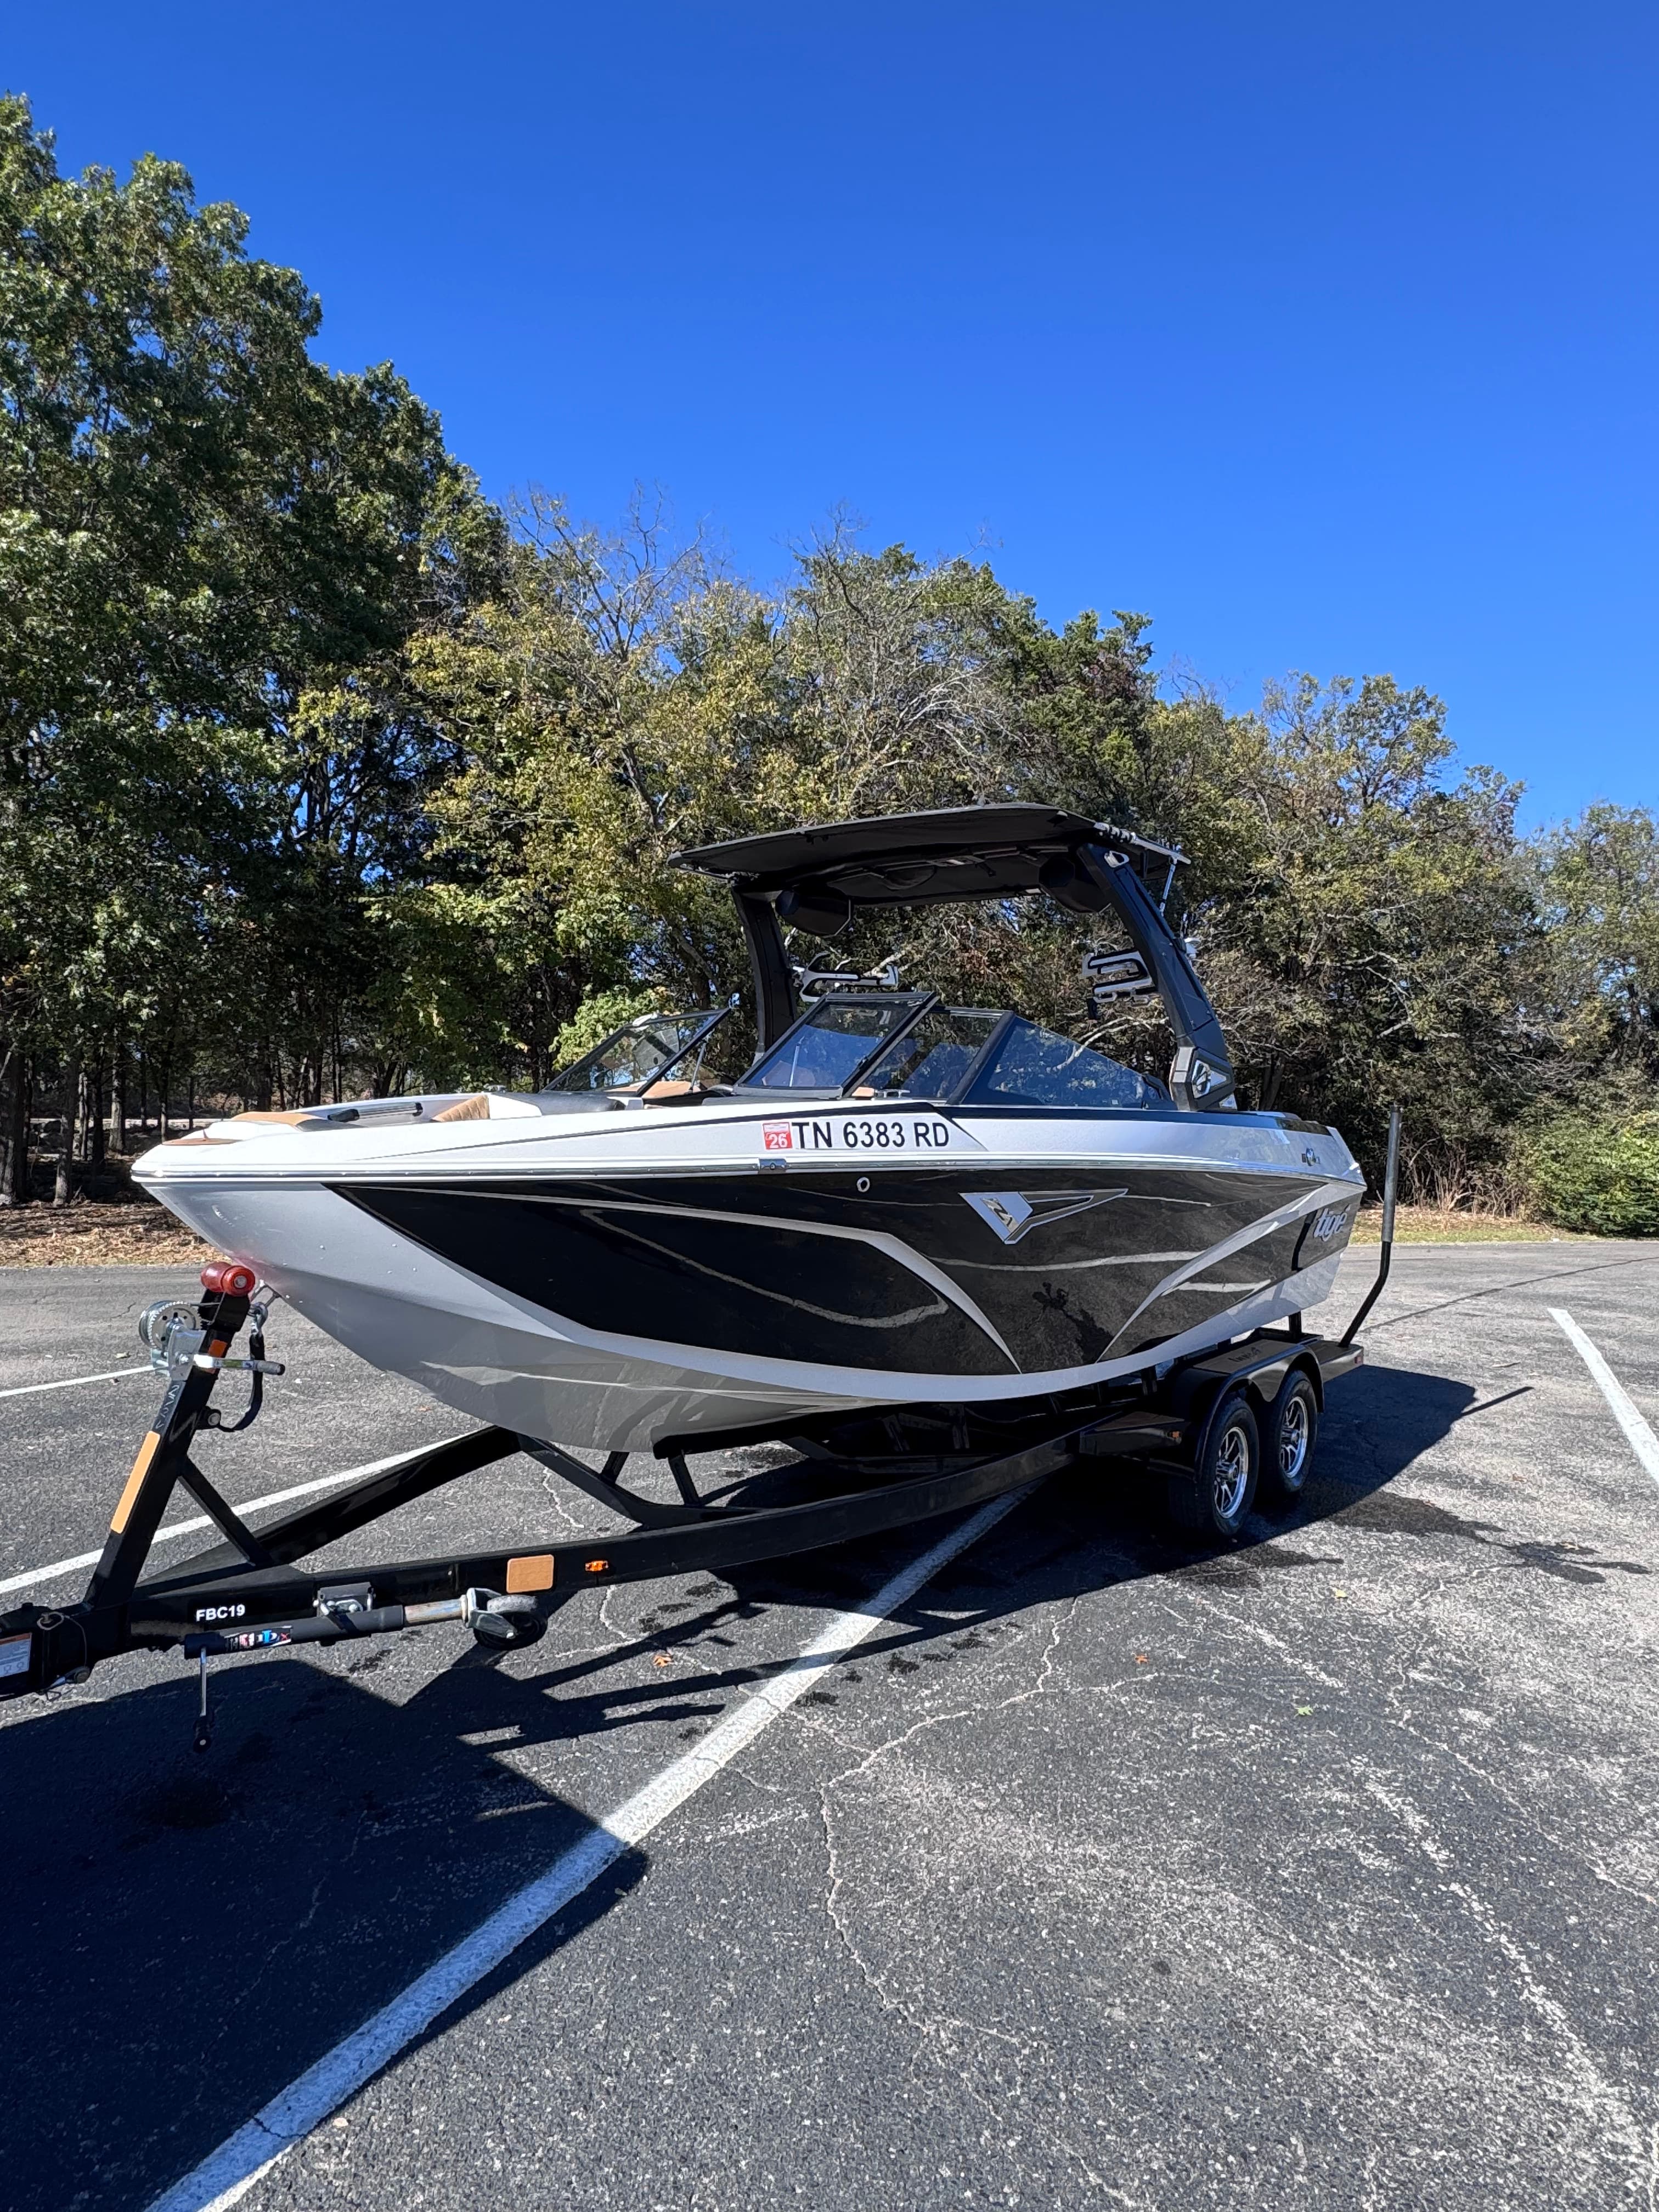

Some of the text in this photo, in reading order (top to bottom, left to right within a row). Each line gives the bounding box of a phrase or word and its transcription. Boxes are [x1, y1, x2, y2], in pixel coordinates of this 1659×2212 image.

[769, 1133, 788, 1149] 26
[792, 1121, 949, 1148] TN 6383 RD
[196, 1604, 245, 1622] FBC19
